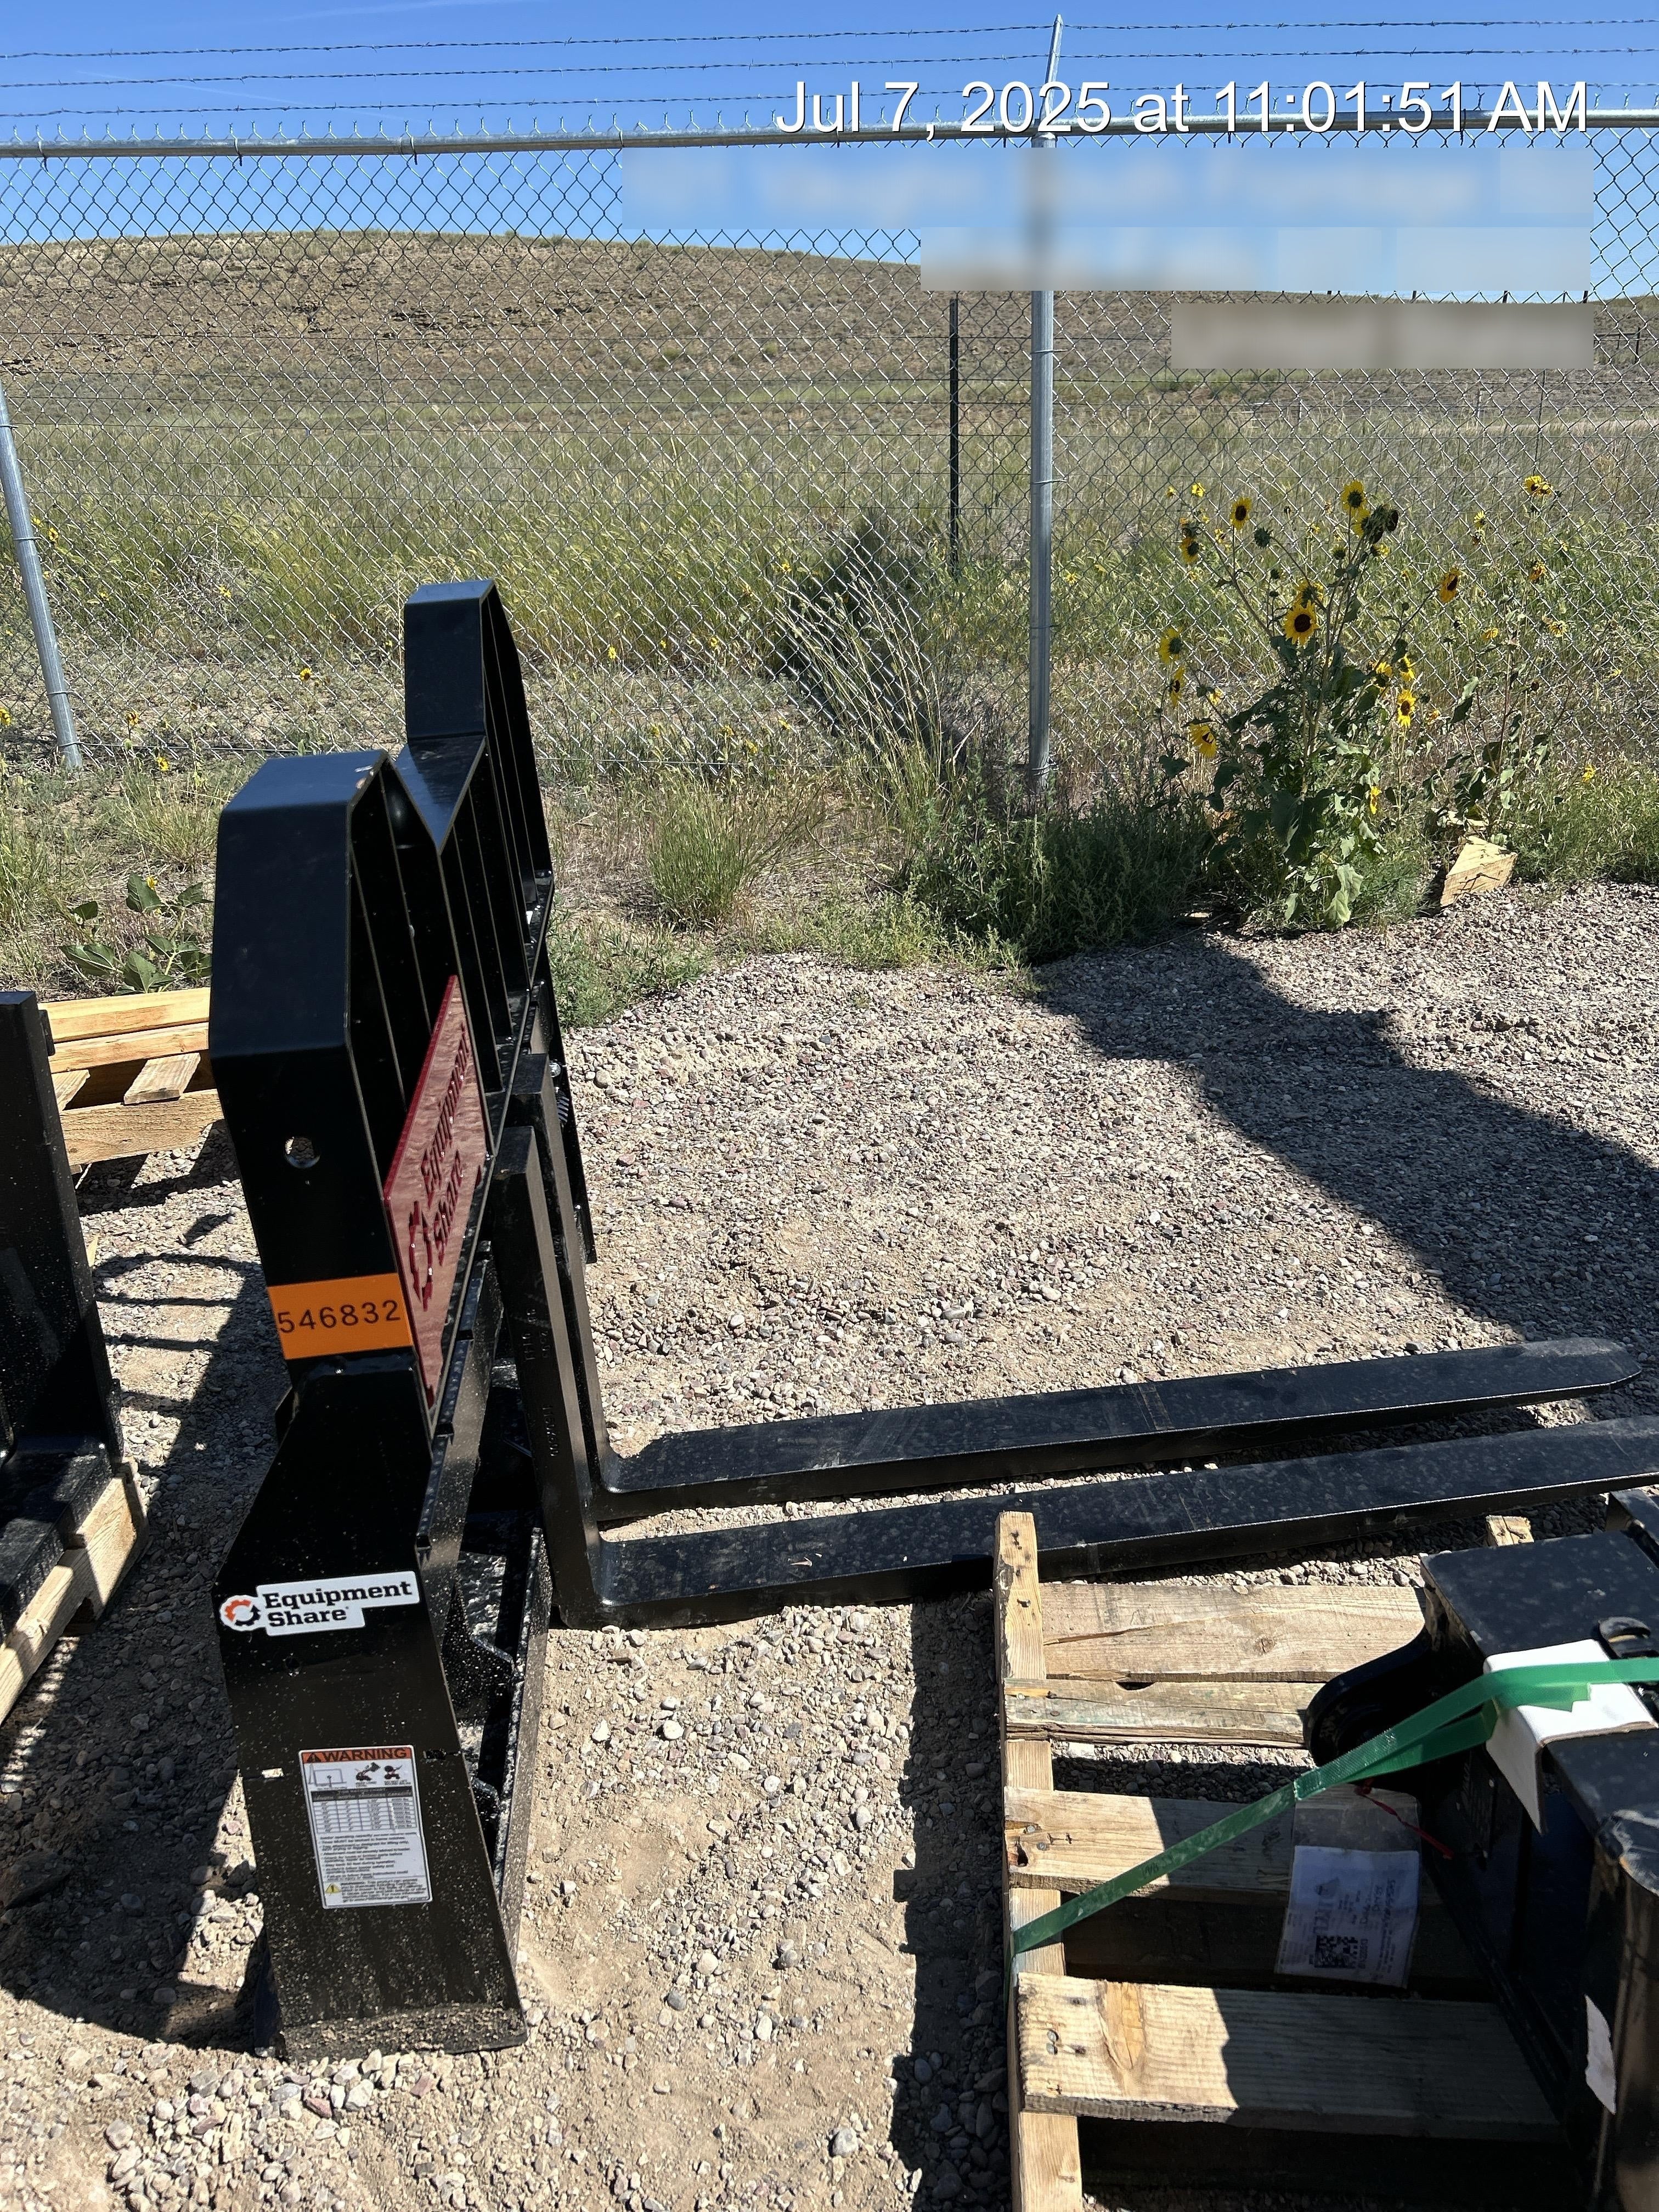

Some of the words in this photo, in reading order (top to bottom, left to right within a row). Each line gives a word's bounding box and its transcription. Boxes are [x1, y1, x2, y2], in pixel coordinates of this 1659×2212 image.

[277, 1299, 401, 1334] 546832
[262, 1581, 413, 1610] Equipment
[267, 1608, 348, 1628] Share
[321, 1748, 407, 1762] WARNING
